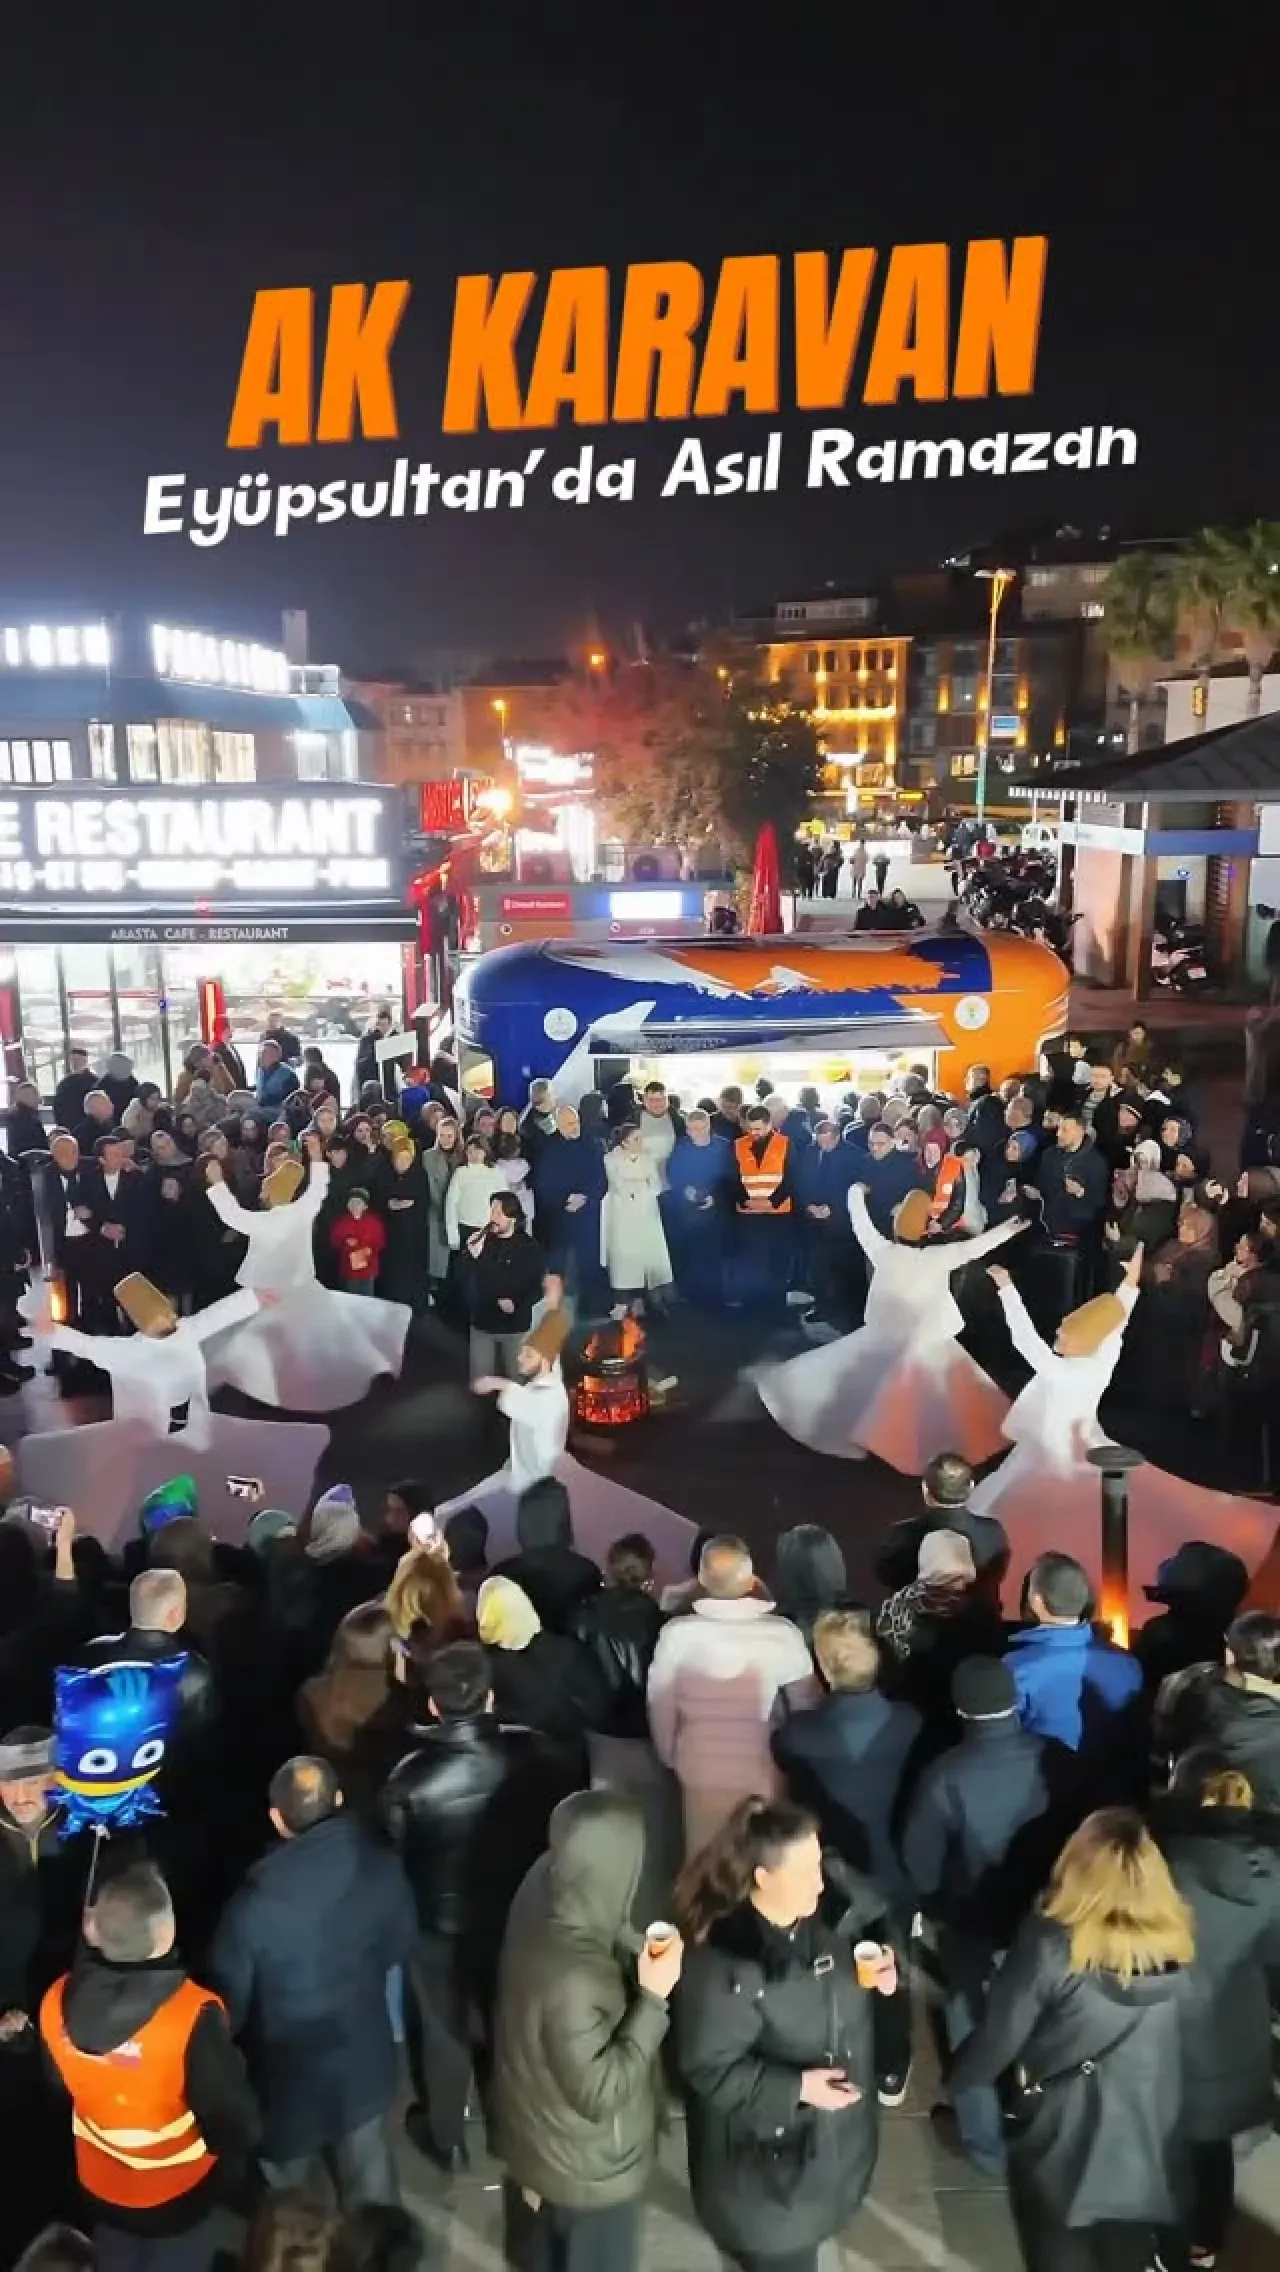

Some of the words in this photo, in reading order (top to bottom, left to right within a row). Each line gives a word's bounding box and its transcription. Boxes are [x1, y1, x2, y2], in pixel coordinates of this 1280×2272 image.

[36, 798, 383, 857] RESTAURANT
[164, 927, 198, 940] CAFE
[208, 927, 289, 940] RESTAURANT
